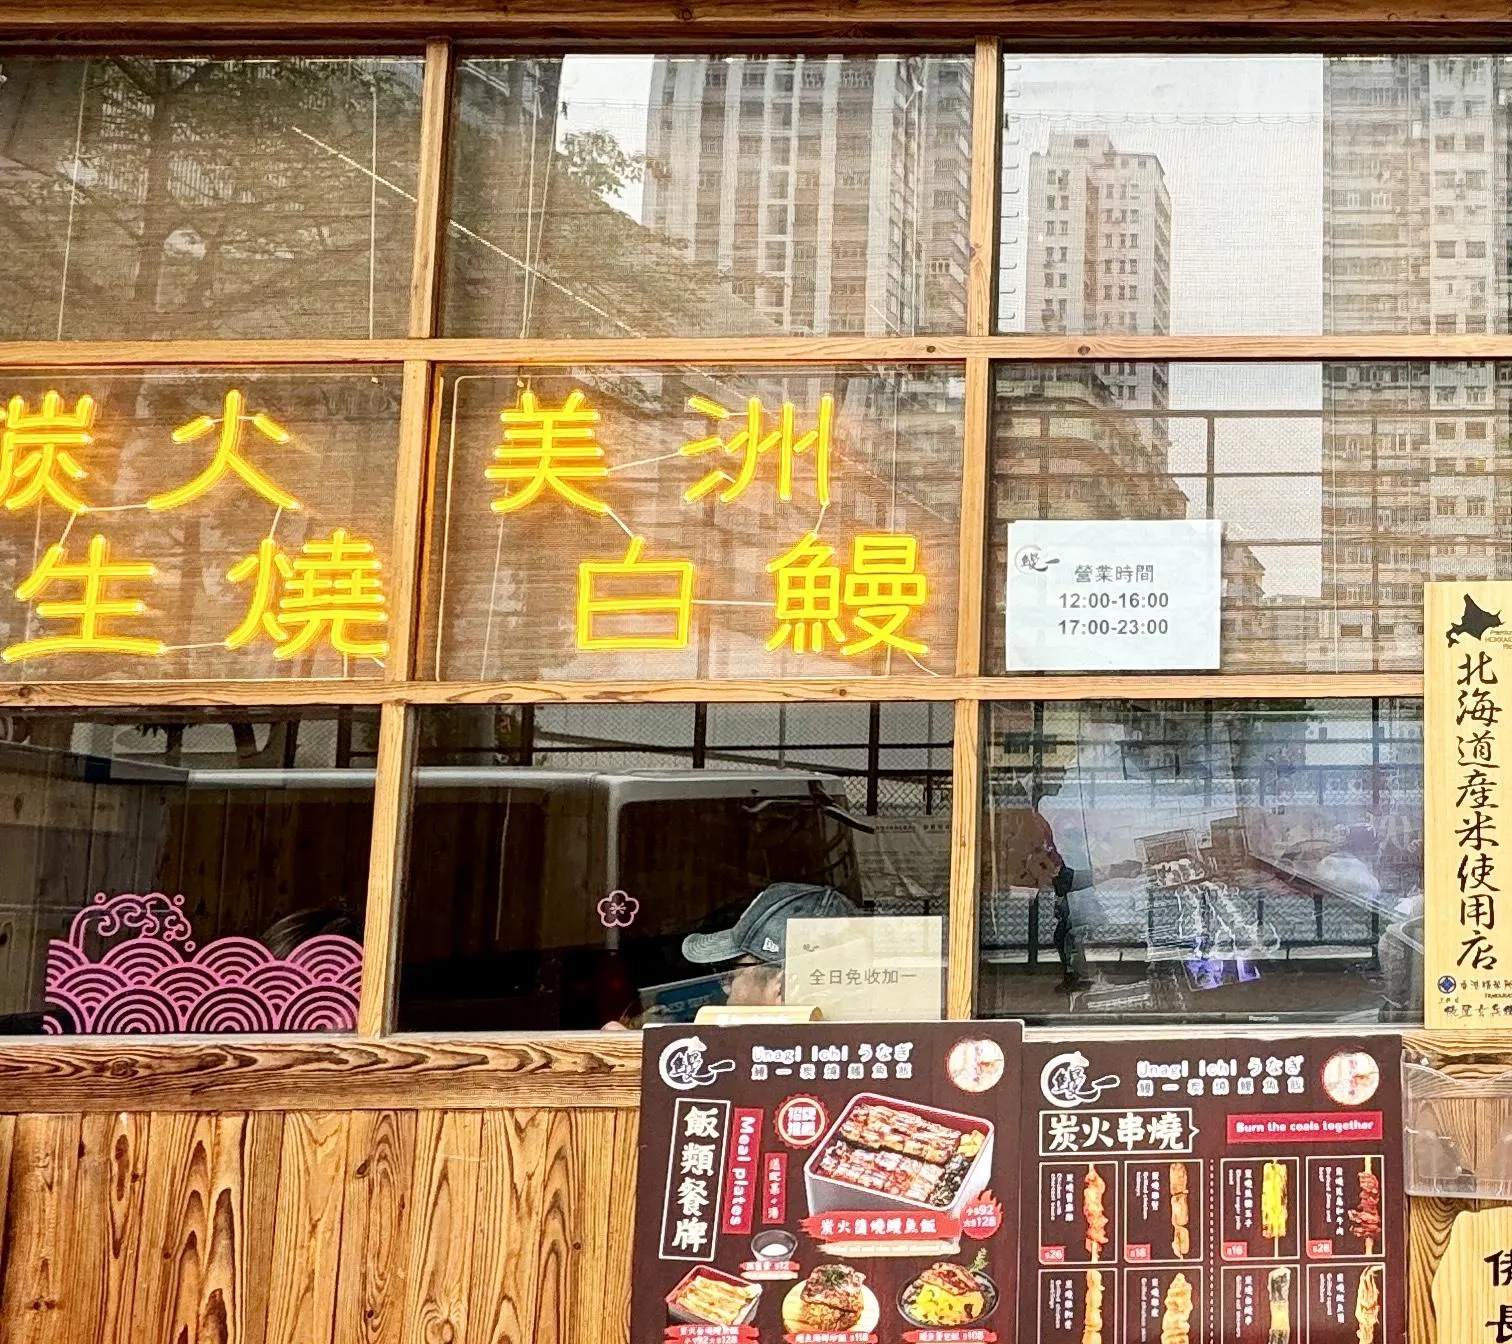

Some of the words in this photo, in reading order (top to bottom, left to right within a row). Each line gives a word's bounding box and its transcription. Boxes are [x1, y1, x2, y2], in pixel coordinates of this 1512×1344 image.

[485, 389, 836, 513] 美洲
[576, 532, 930, 656] 白鰻
[1074, 564, 1154, 583] 營業時間
[1058, 593, 1169, 608] 12:00-16:00
[1058, 619, 1169, 635] 17:00-23:00
[809, 968, 917, 985] 全日免收加一
[736, 1116, 756, 1162] Meal
[1048, 1111, 1184, 1152] 炭火串燒
[1235, 1120, 1265, 1133] Burn
[1267, 1121, 1287, 1132] the
[1289, 1120, 1320, 1132] coals
[1323, 1119, 1375, 1133] together
[671, 1106, 720, 1253] 飯類餐牌
[730, 1168, 749, 1226] plates
